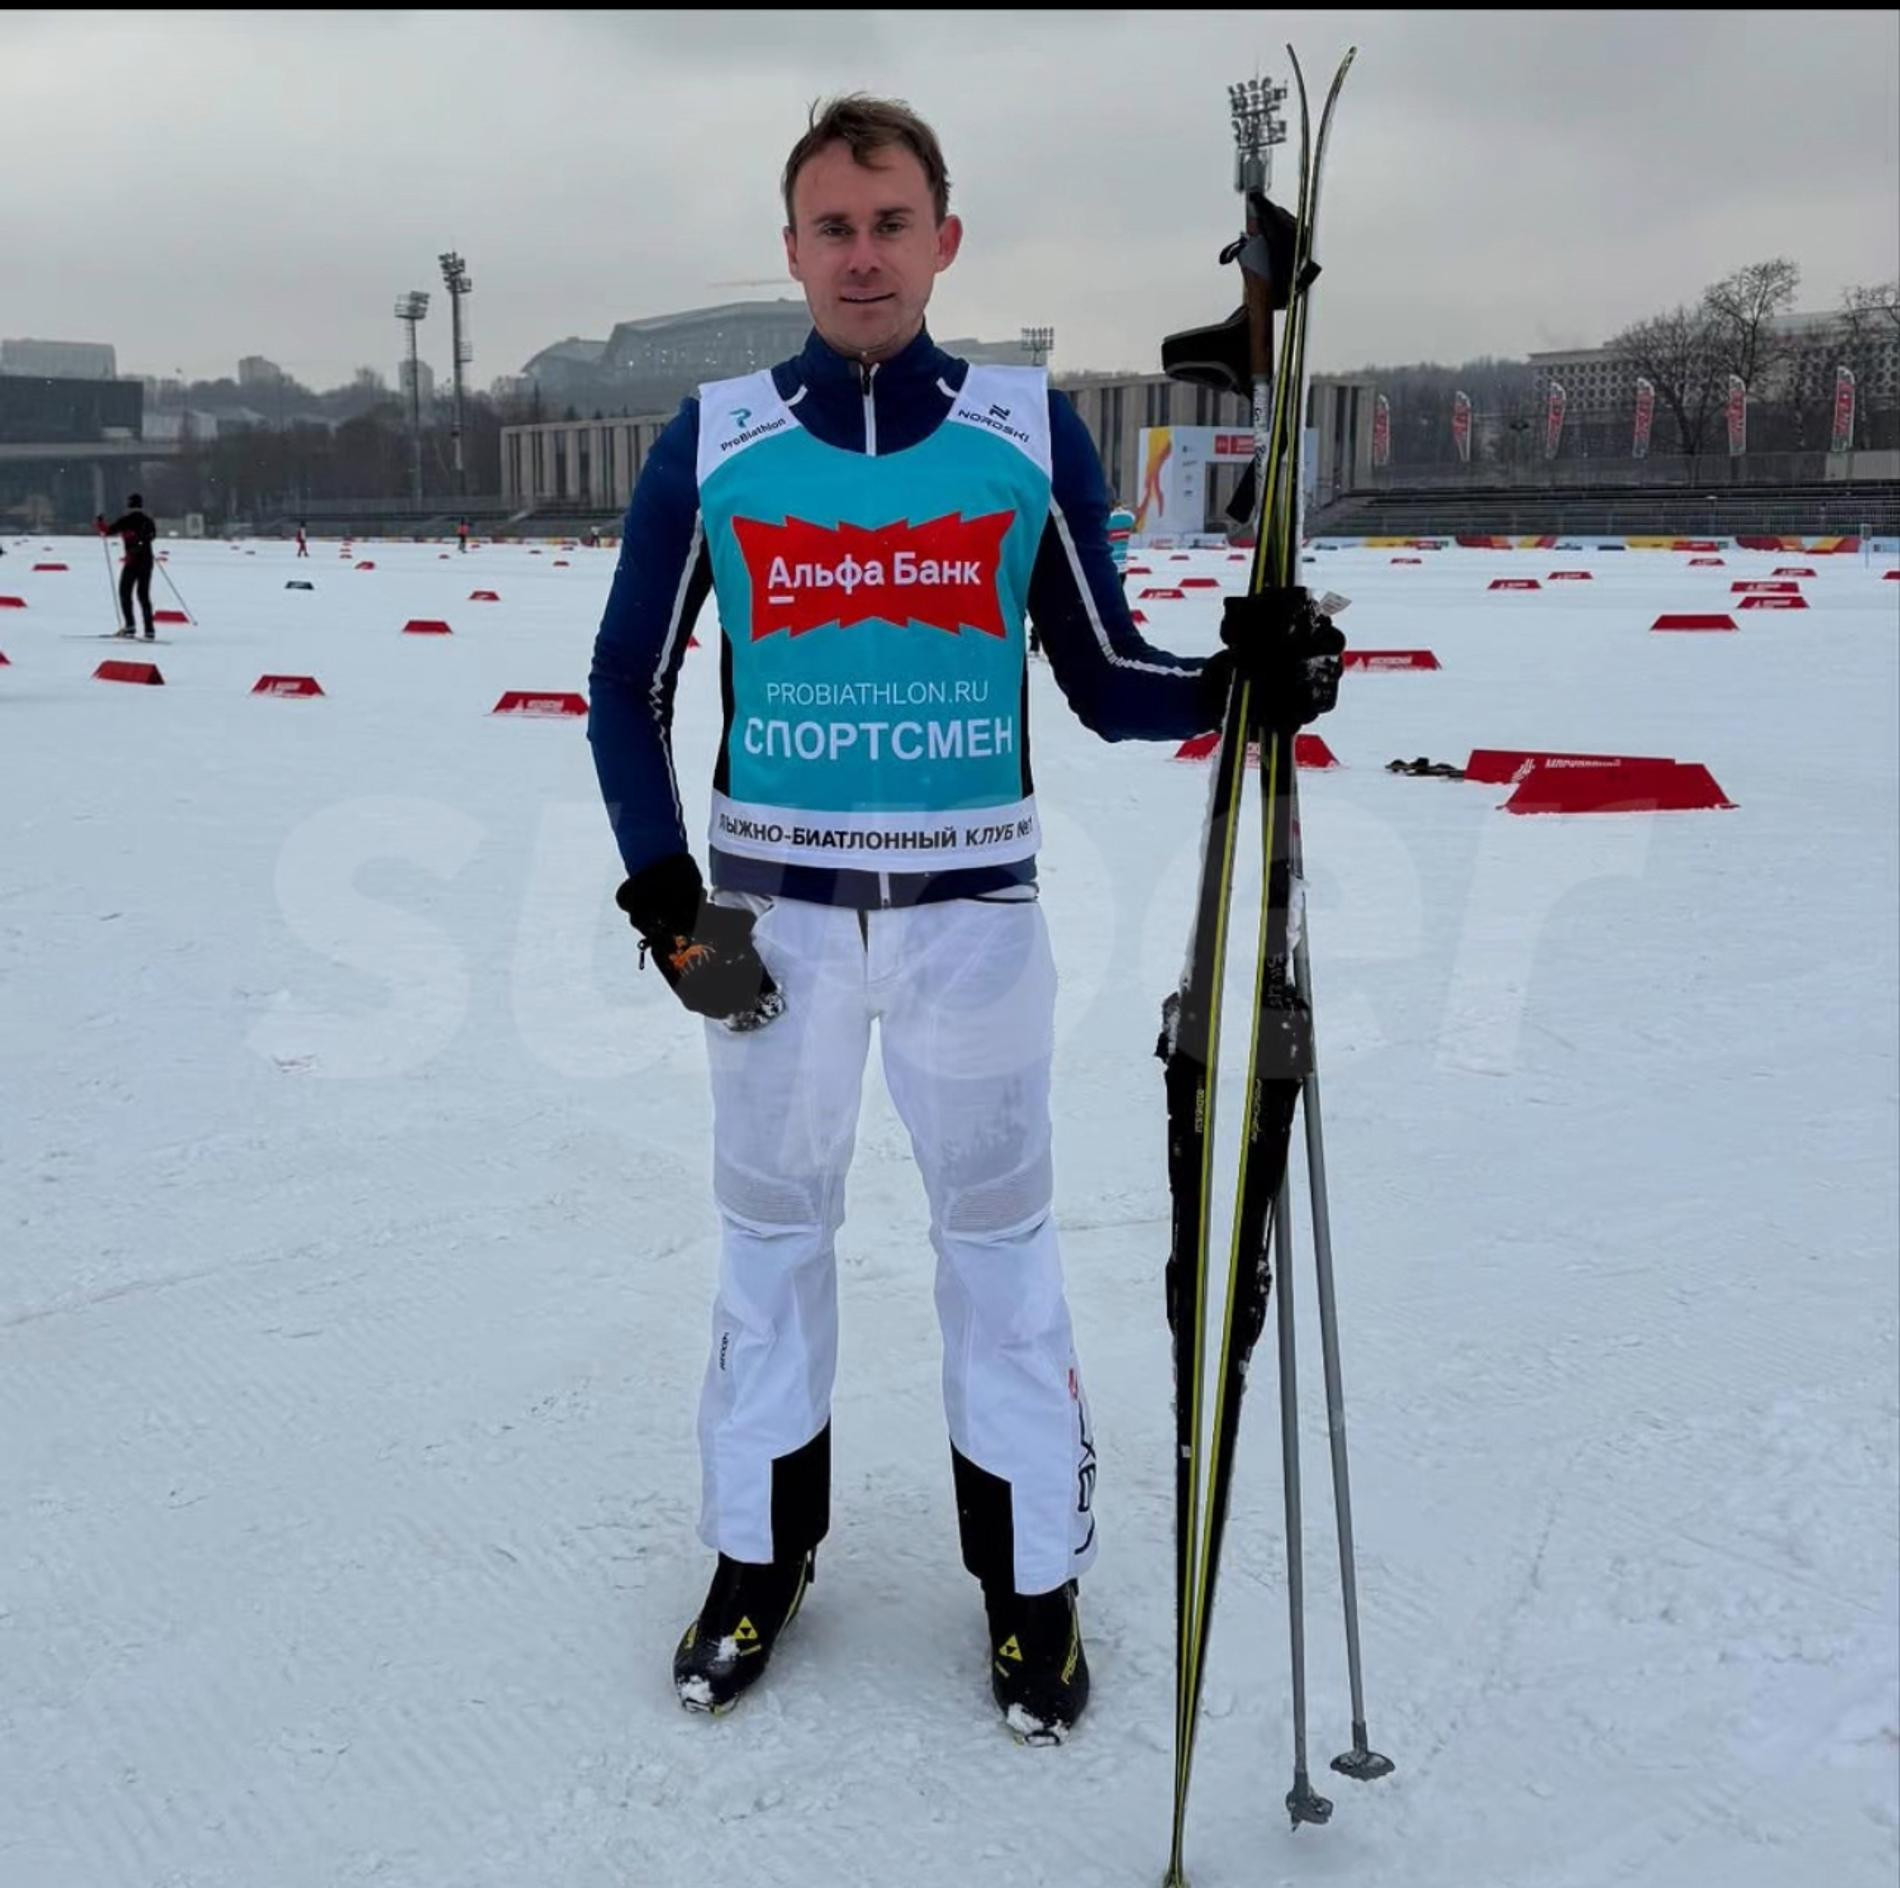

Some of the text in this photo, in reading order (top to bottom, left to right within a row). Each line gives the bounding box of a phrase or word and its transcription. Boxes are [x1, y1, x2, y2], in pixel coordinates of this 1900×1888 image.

[721, 418, 786, 451] ProBiathlon
[958, 409, 1029, 442] NORDSKI
[768, 552, 981, 595] Альфа Банк
[766, 680, 989, 705] PROBIATHLON.RU
[744, 716, 1014, 761] СПОРТСМЕН
[965, 823, 1015, 847] КЛУБ
